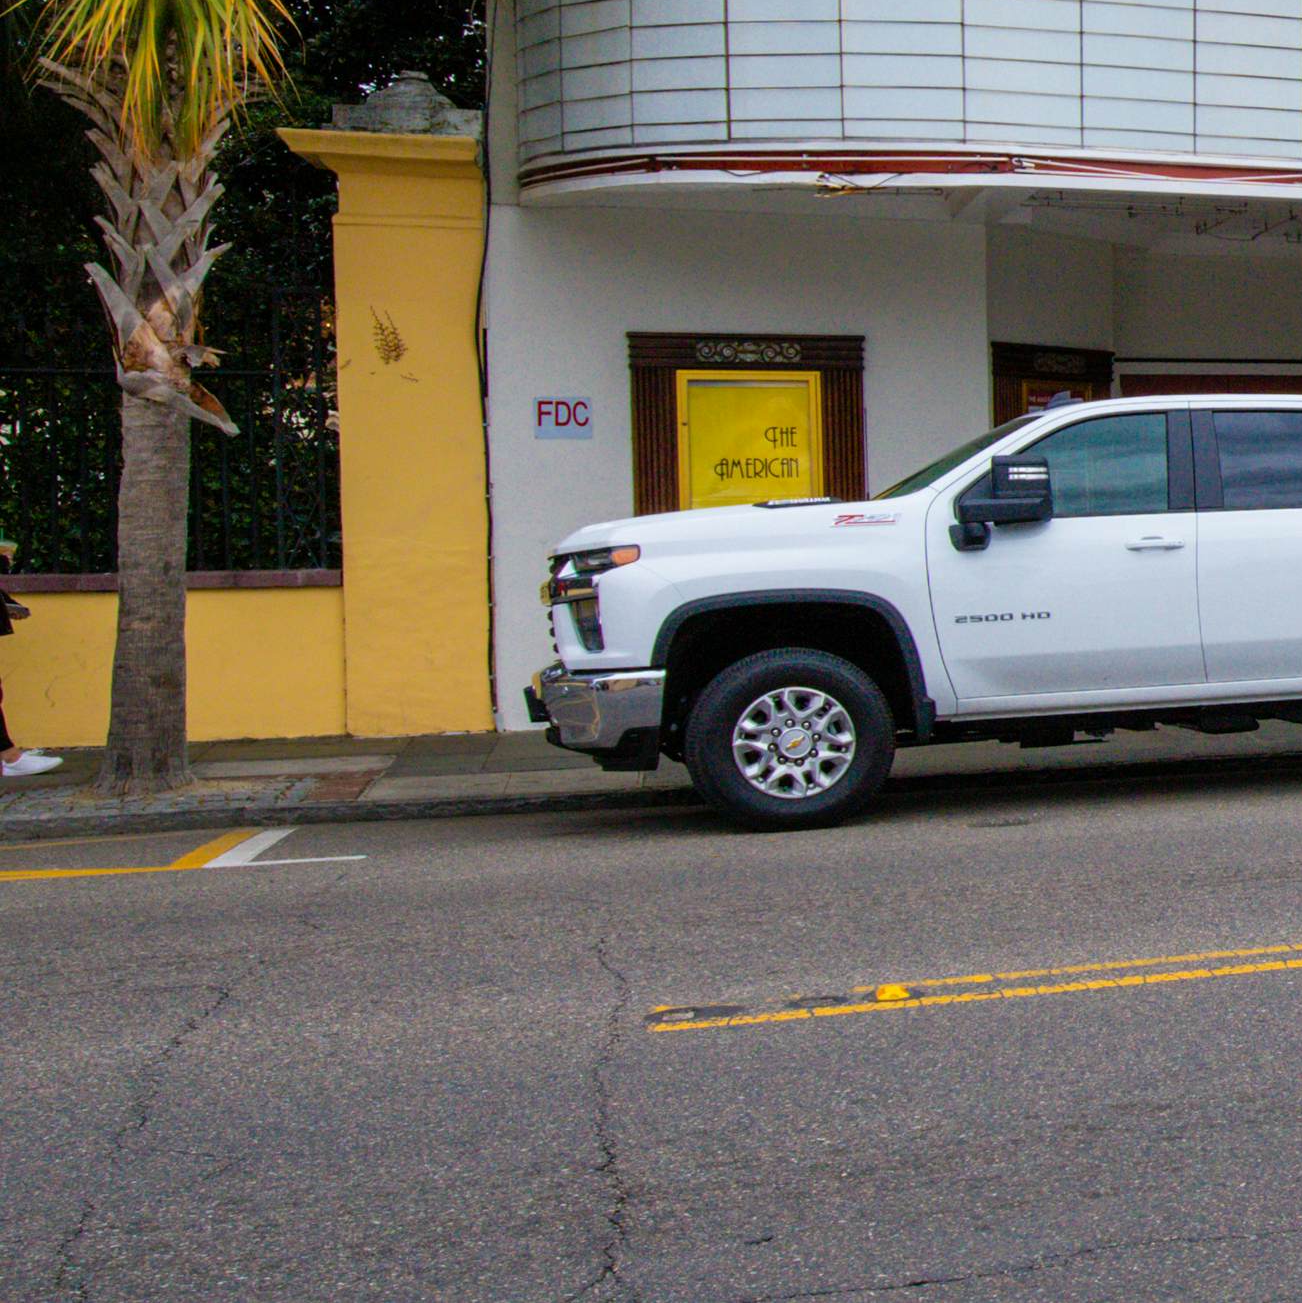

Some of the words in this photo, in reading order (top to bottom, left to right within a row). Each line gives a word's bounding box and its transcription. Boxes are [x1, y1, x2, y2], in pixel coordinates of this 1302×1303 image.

[537, 400, 590, 427] FDC
[764, 426, 798, 448] THE
[713, 457, 800, 481] AMERICAN
[954, 613, 1014, 624] 2500
[1021, 611, 1051, 621] HD
